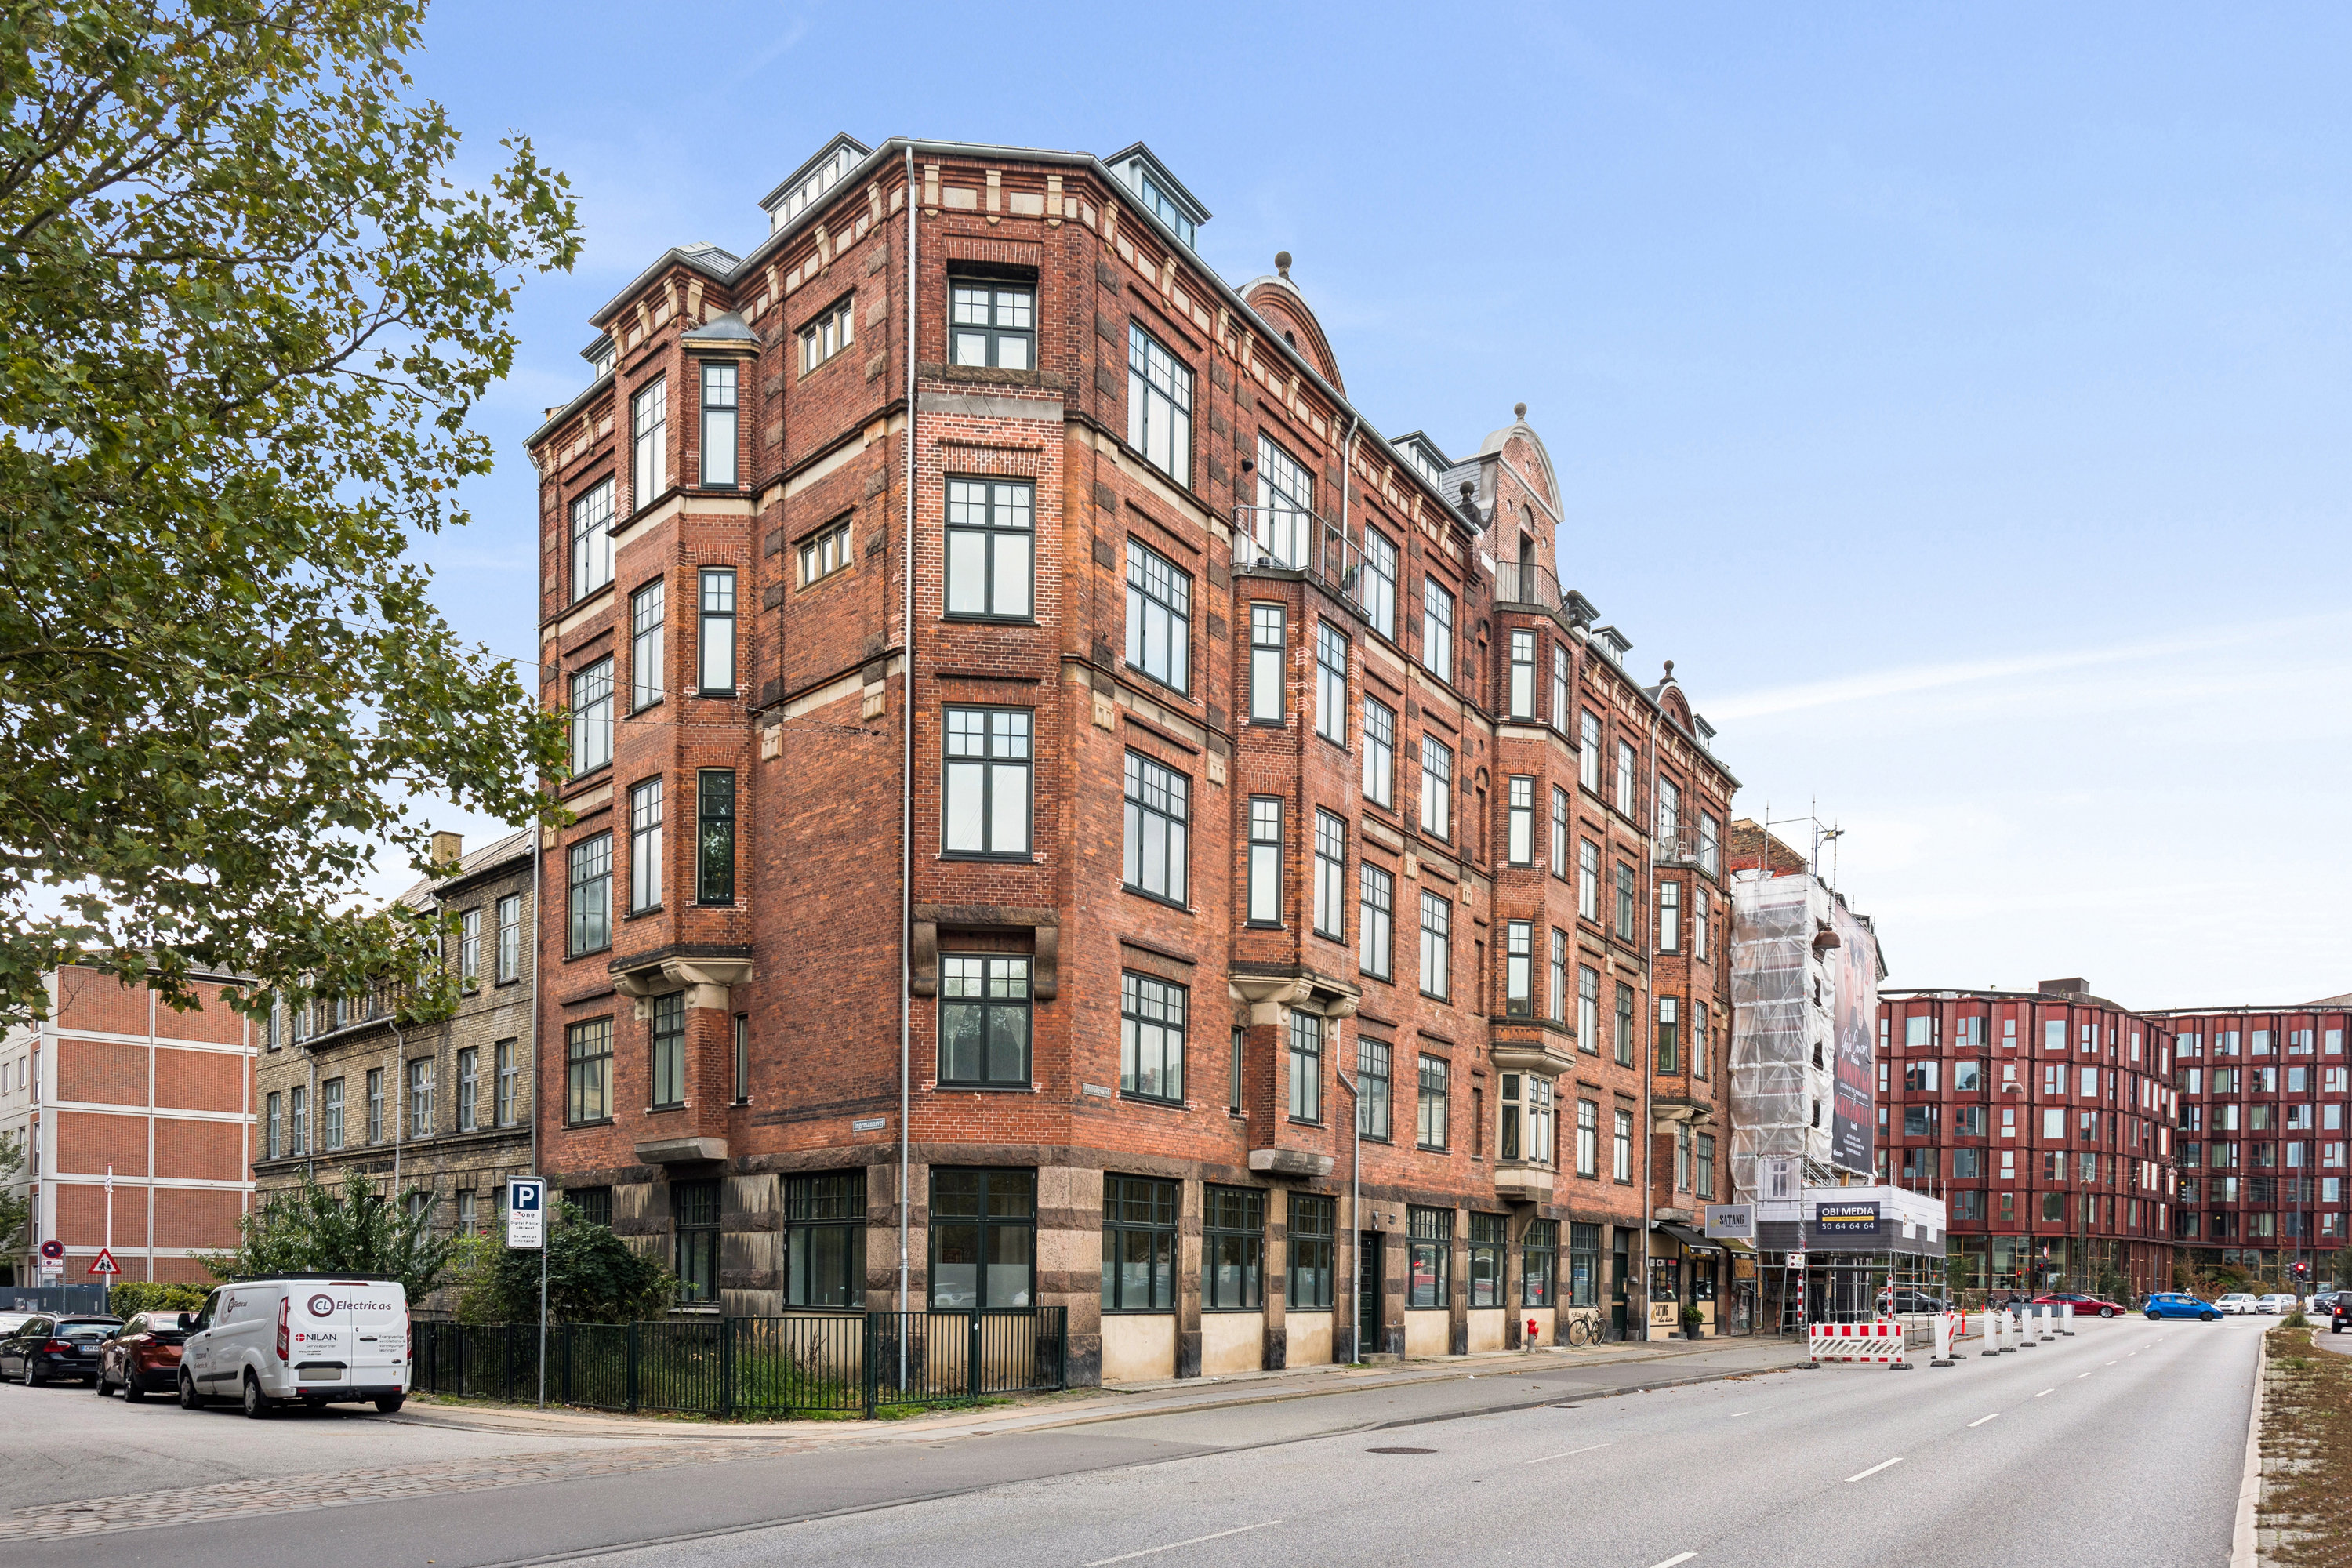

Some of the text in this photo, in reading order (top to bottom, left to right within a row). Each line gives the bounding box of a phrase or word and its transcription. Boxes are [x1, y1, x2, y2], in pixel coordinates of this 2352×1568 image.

[1838, 1056, 1872, 1094] DOMINGO
[855, 1120, 884, 1130] Ingemannsvej
[519, 1186, 535, 1207] P
[1719, 1214, 1744, 1225] SATANG
[315, 1301, 329, 1310] CL
[336, 1301, 377, 1310] Electric
[1656, 1305, 1668, 1316] SATANG
